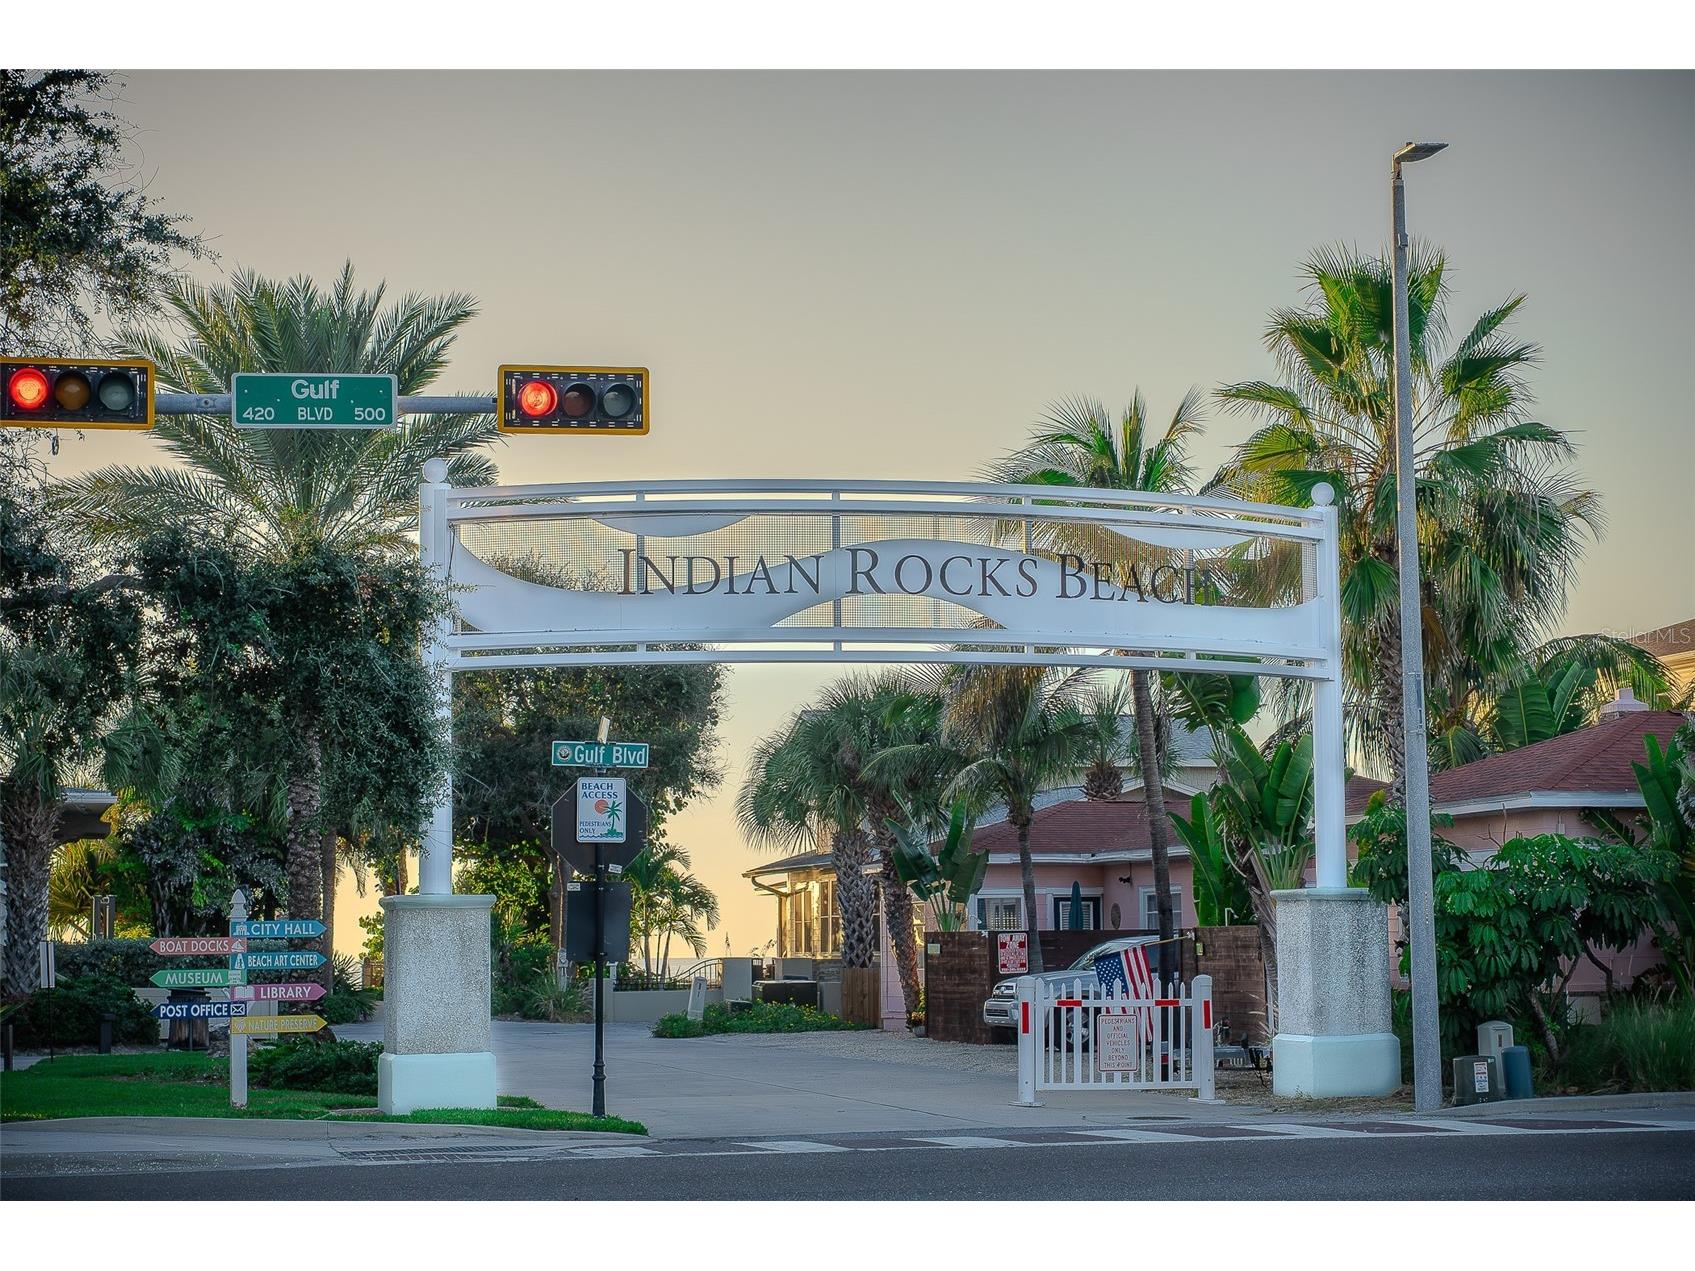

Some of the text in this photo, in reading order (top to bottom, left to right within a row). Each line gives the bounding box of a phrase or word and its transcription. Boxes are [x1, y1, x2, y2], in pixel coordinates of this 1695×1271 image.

[291, 379, 340, 399] Gulf
[243, 407, 386, 421] 420 BLVD 500
[617, 548, 825, 595] INDIAN
[845, 548, 1038, 598] ROCKS
[574, 745, 646, 765] Gulf Blvd
[581, 782, 613, 790] BEACH
[581, 791, 618, 799] ACCESS
[251, 922, 316, 936] CITY HALL
[160, 940, 229, 953] BOAT DOCKS
[248, 954, 318, 967] BEACH ART CENTER
[165, 972, 223, 985] MUSEUM
[260, 986, 312, 999] LIBRARY
[160, 1003, 228, 1018] POST OFFICE
[249, 1018, 317, 1031] NATURE PRESERVE
